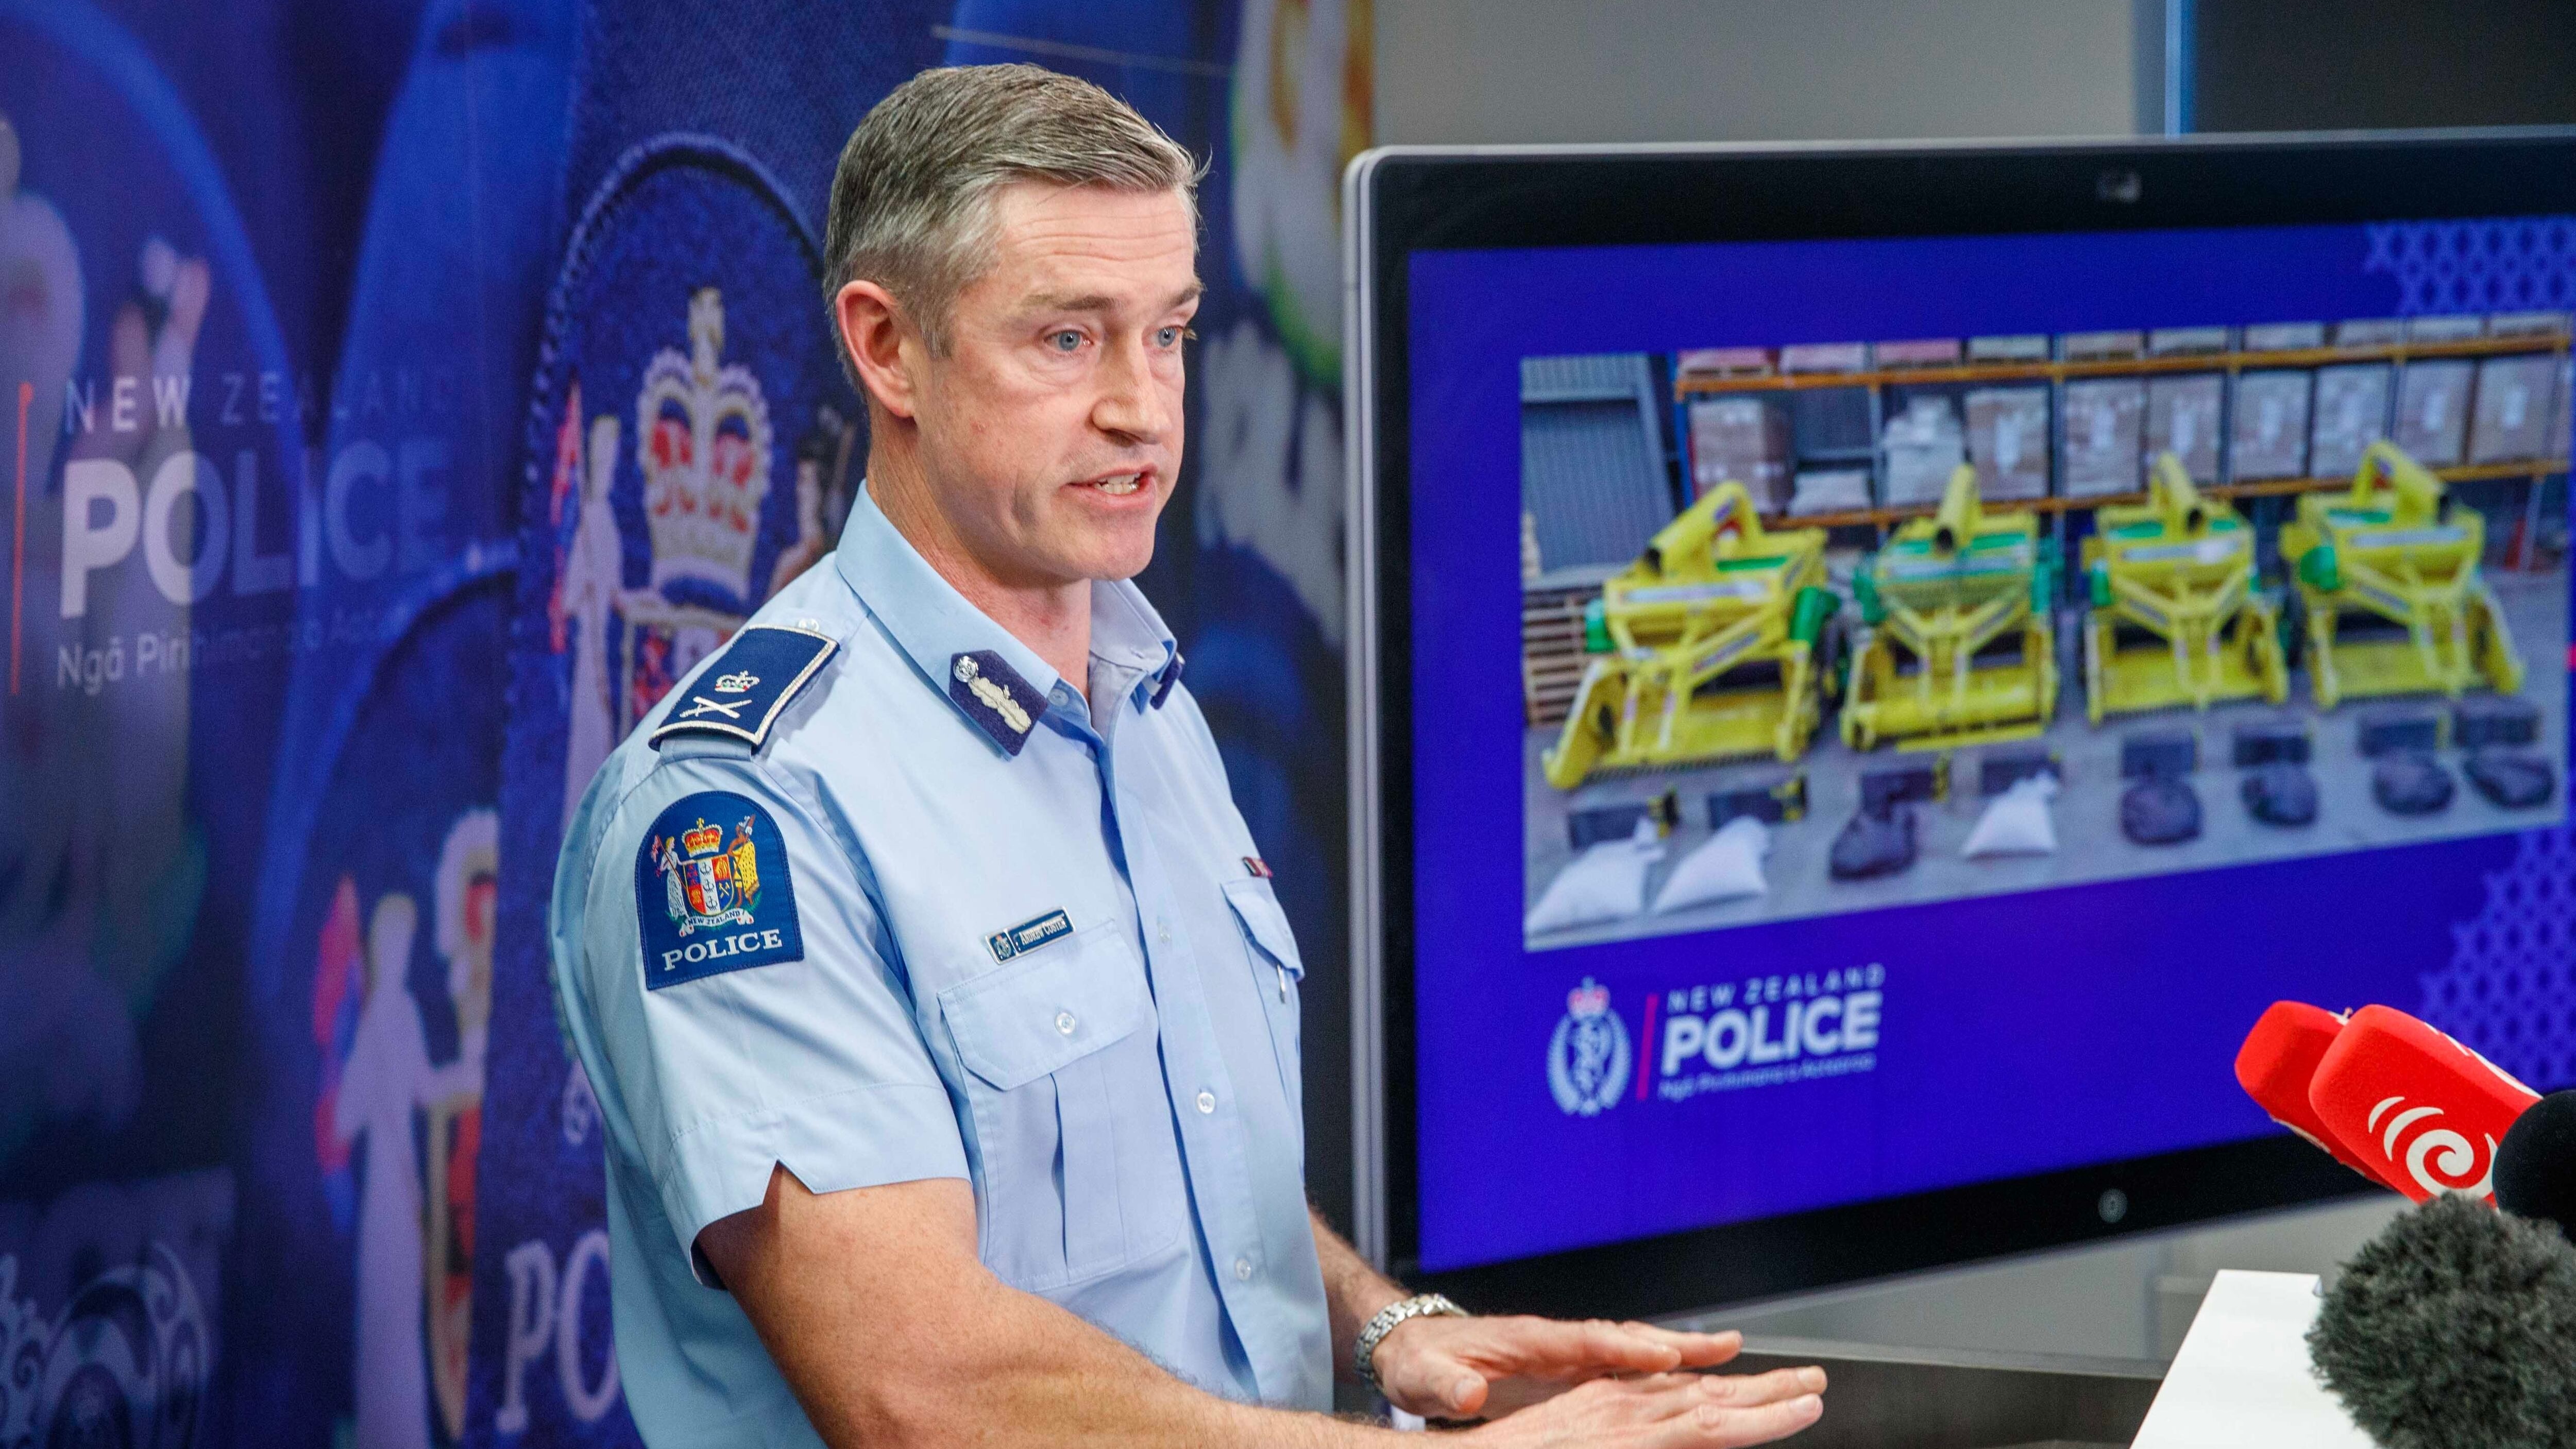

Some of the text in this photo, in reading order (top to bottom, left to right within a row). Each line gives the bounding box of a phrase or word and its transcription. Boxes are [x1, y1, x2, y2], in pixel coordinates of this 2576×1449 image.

[64, 374, 191, 434] NEW
[60, 437, 450, 619] POLICE
[707, 910, 741, 925] ZEALAND
[662, 929, 783, 971] POLICE
[1667, 962, 1886, 1013] NEW ZEALAND
[1660, 990, 1883, 1076] POLICE
